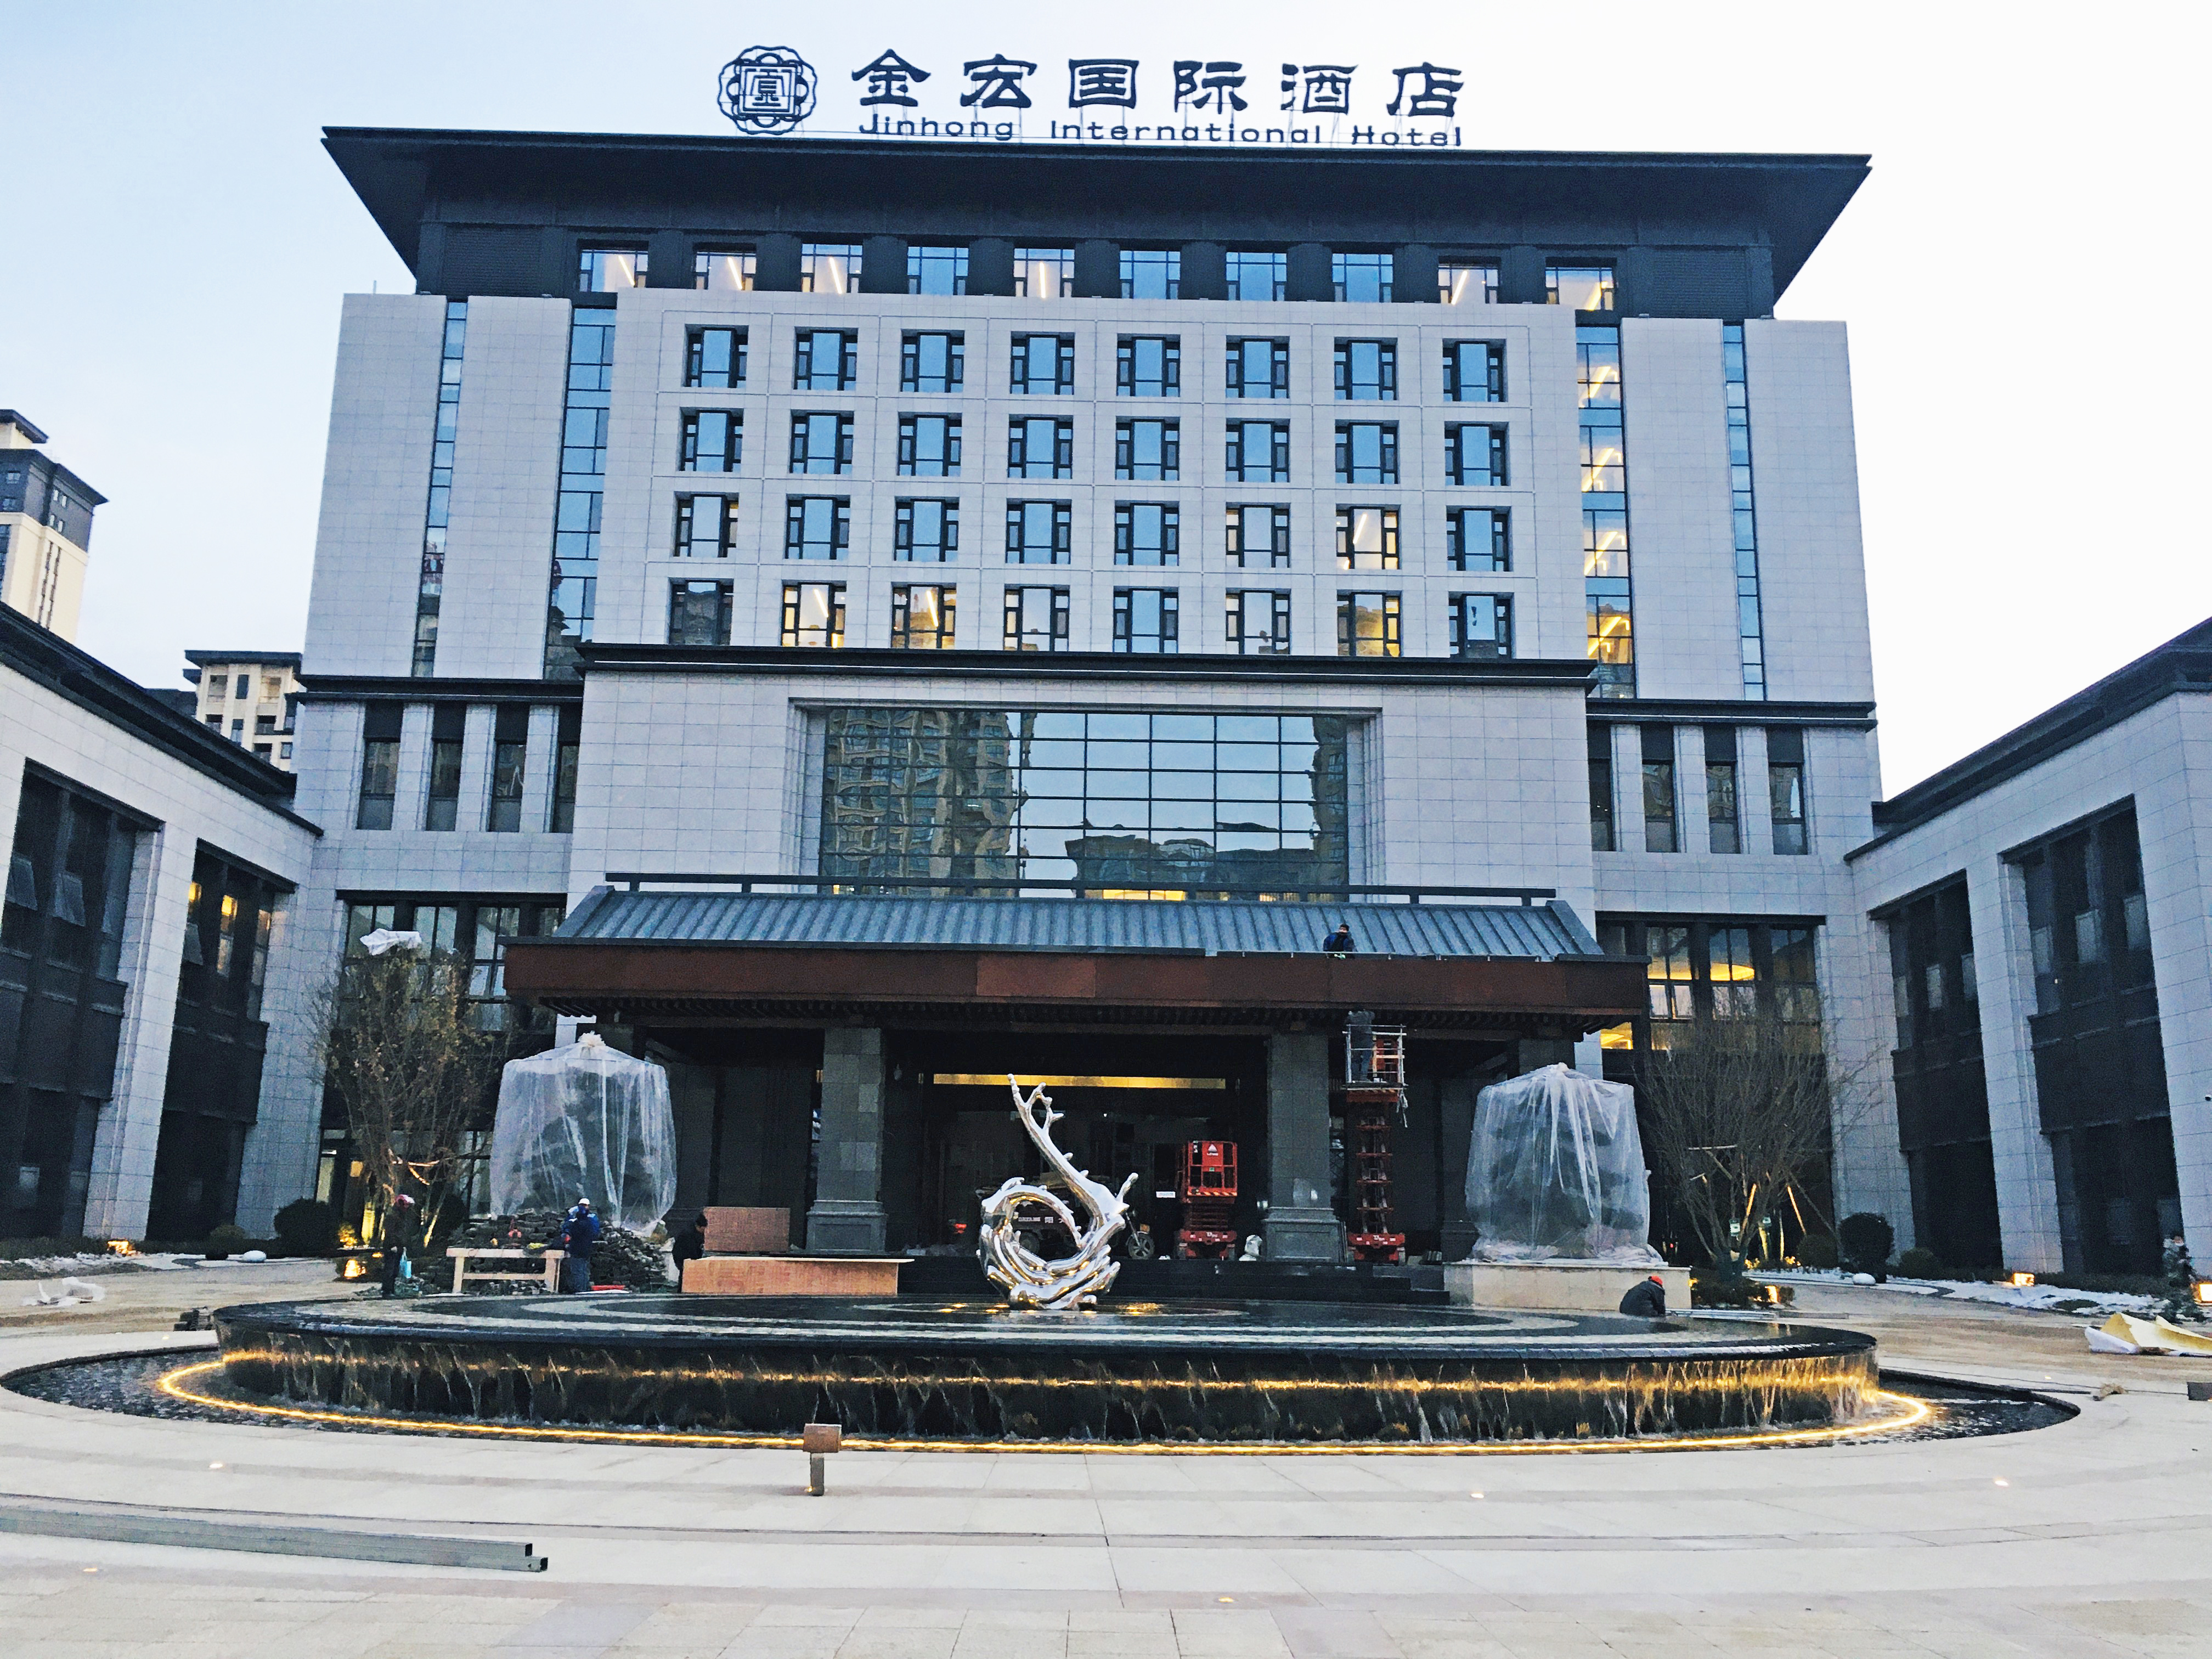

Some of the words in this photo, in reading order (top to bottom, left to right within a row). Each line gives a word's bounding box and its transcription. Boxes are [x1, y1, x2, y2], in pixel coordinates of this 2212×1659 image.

[851, 49, 1464, 117] 金宏国际酒店
[859, 113, 1013, 141] Jinhong
[1051, 121, 1320, 144] International
[1352, 125, 1462, 146] Hotel
